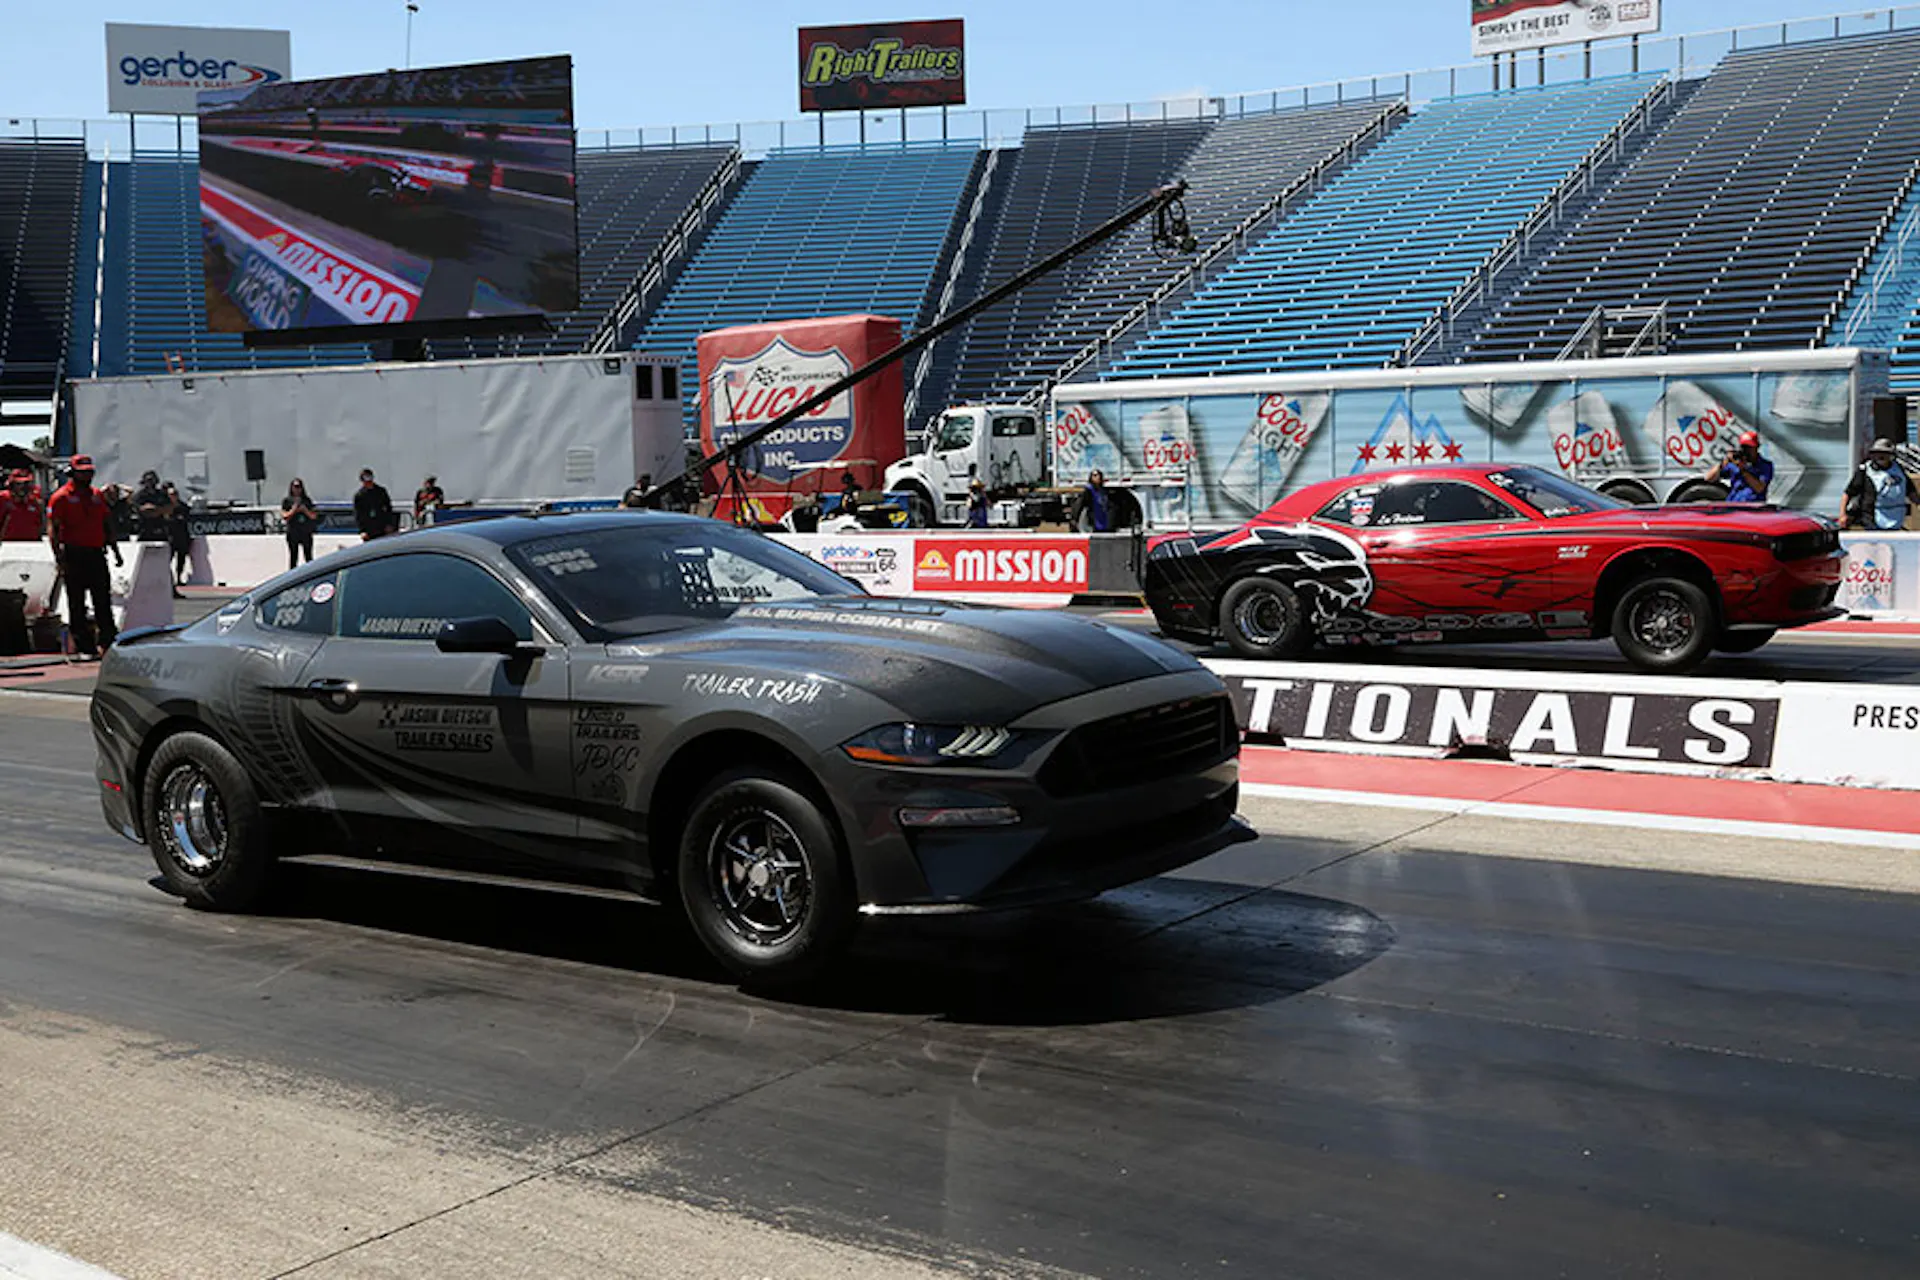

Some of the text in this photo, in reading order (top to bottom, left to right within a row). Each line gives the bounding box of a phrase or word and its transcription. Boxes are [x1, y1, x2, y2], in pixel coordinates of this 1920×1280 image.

[1478, 13, 1570, 36] SIMPLY THE BEST
[120, 51, 237, 85] gerber
[278, 242, 409, 323] MISSION
[761, 427, 844, 445] RODUCTS
[821, 546, 860, 562] gerber
[879, 558, 897, 572] 66
[955, 550, 1086, 583] MISSION
[1849, 584, 1890, 596] LIGHT
[359, 616, 400, 633] JASON
[774, 609, 838, 623] SUPER
[836, 613, 904, 630] COBRA
[903, 619, 944, 633] JET
[681, 673, 822, 704] TRAILER TRASH
[400, 707, 493, 725] JASON DIETSCH
[1240, 679, 1756, 766] TIONALS
[1853, 704, 1919, 730] PRES
[395, 731, 493, 752] TRAILER SALES
